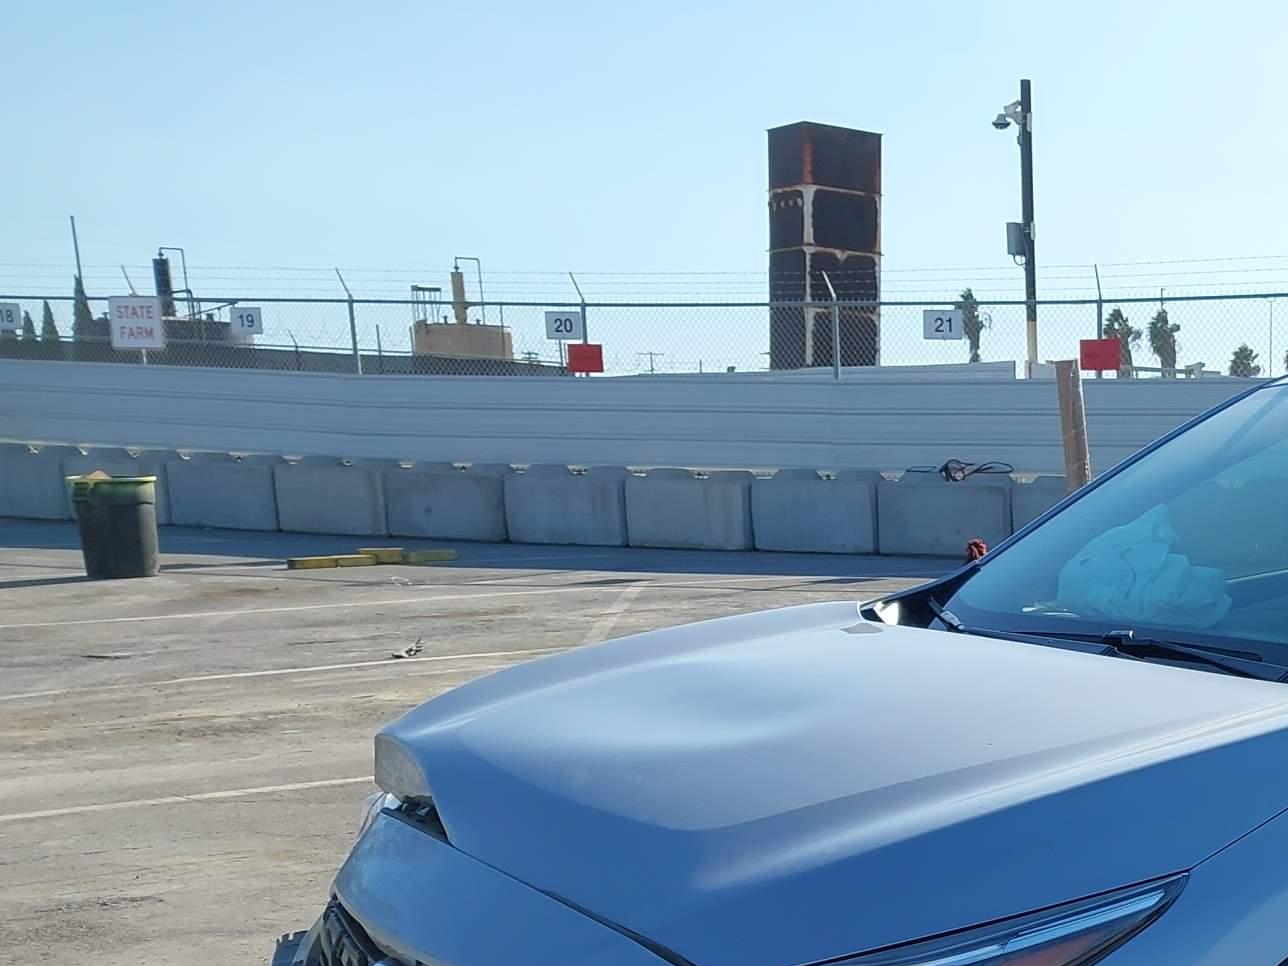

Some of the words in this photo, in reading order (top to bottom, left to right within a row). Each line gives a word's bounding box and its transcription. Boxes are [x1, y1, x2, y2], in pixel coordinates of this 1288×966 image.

[115, 305, 153, 320] STATE
[238, 314, 255, 328] 19
[554, 318, 573, 333] 20
[934, 317, 953, 333] 21
[119, 326, 154, 340] FARM
